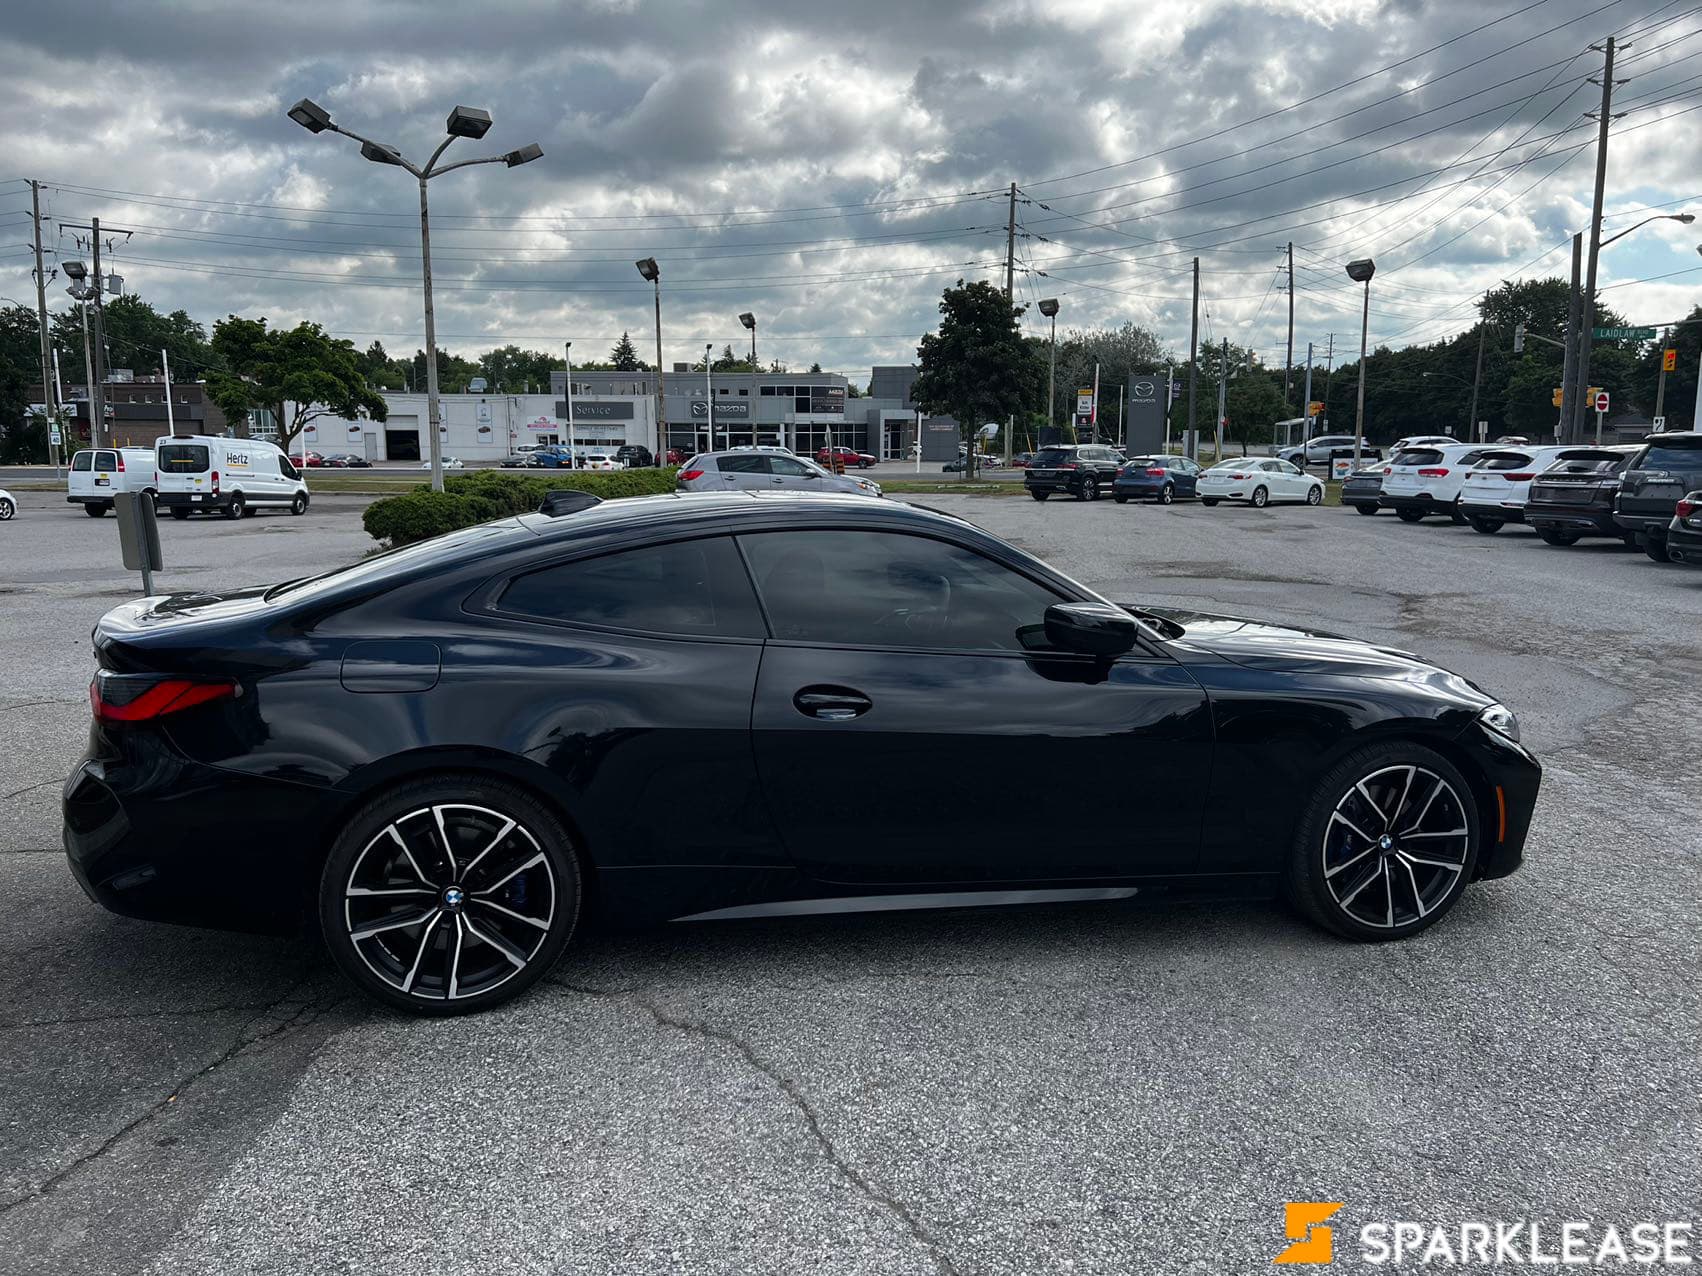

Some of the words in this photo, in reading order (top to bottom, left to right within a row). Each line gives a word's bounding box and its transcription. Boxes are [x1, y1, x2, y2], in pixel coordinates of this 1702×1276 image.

[1600, 328, 1636, 338] LAIDLAW
[576, 405, 611, 415] Service
[226, 452, 249, 465] Hertz
